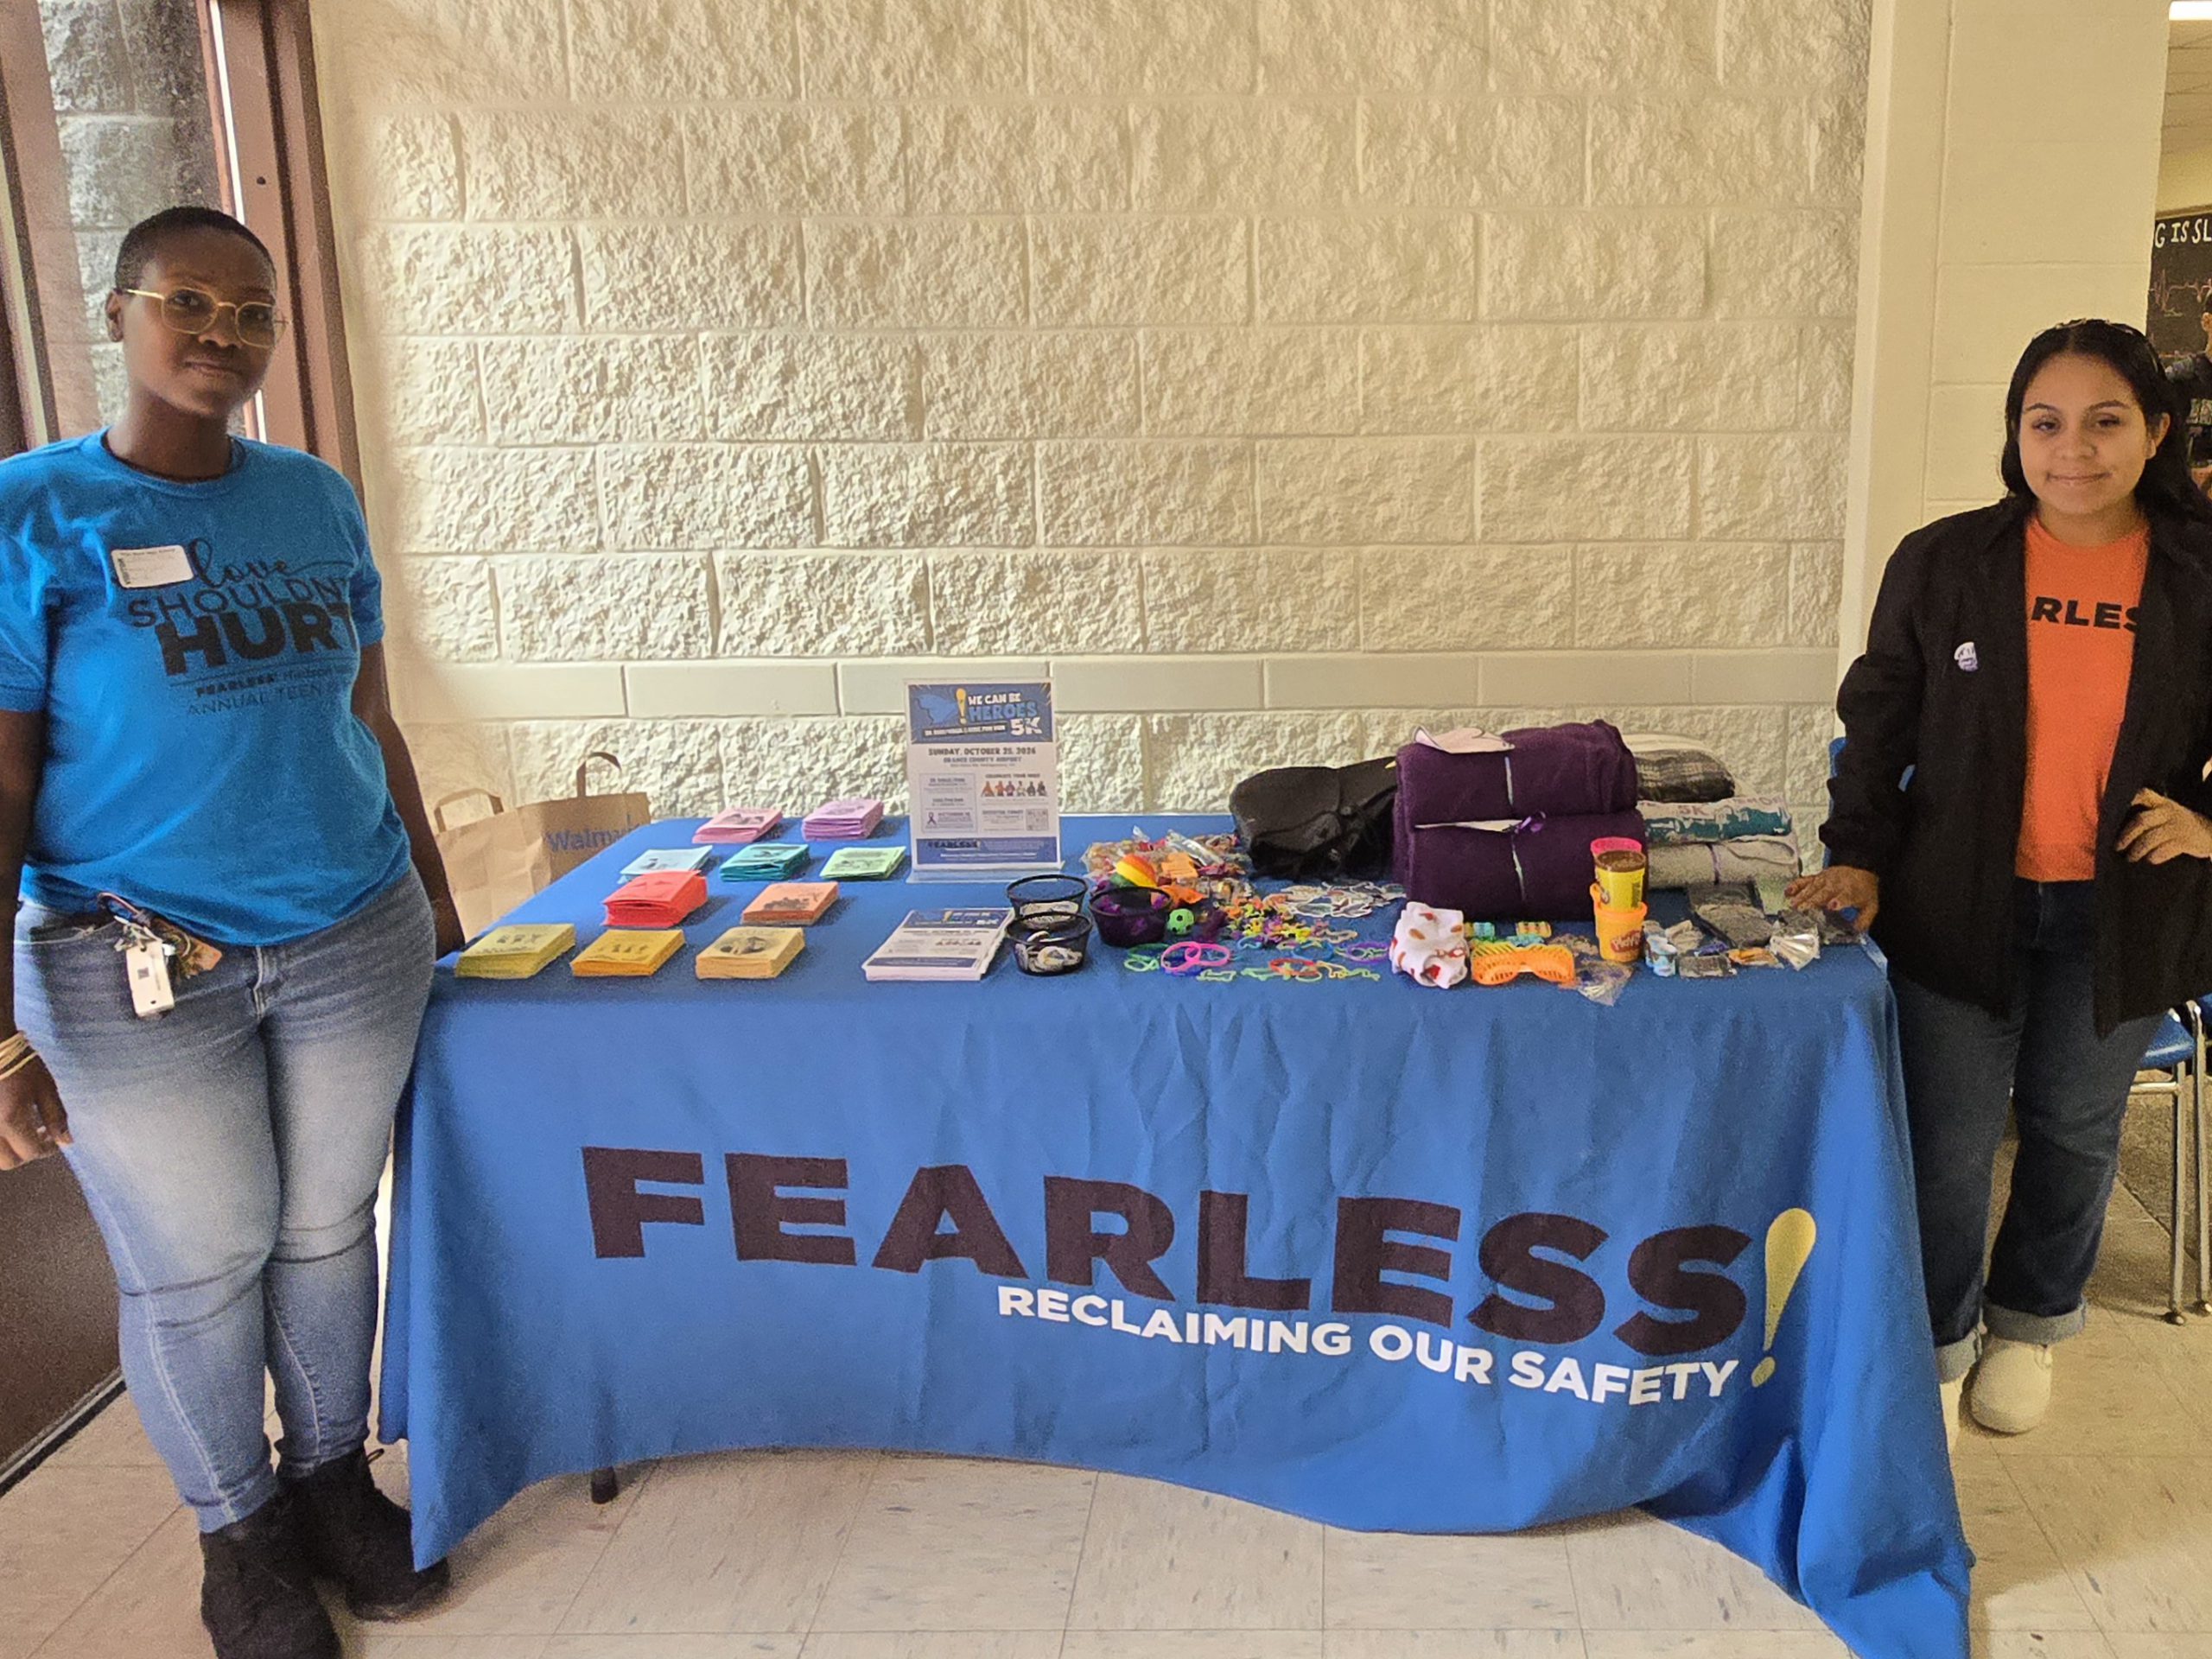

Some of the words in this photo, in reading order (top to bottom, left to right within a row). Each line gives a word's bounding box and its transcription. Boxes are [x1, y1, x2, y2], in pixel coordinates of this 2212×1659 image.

[2170, 219, 2190, 243] IS
[968, 695, 982, 705] WE
[984, 693, 1007, 704] CAN
[1008, 692, 1021, 702] BE
[969, 702, 1037, 721] HEROES
[1010, 716, 1043, 736] 5K
[964, 747, 1001, 756] OCTOBER
[582, 1146, 1816, 1387] FEARLESS!
[997, 1286, 1352, 1357] RECLAIMING
[1369, 1324, 1493, 1384] OUR
[1508, 1351, 1738, 1405] SAFETY
